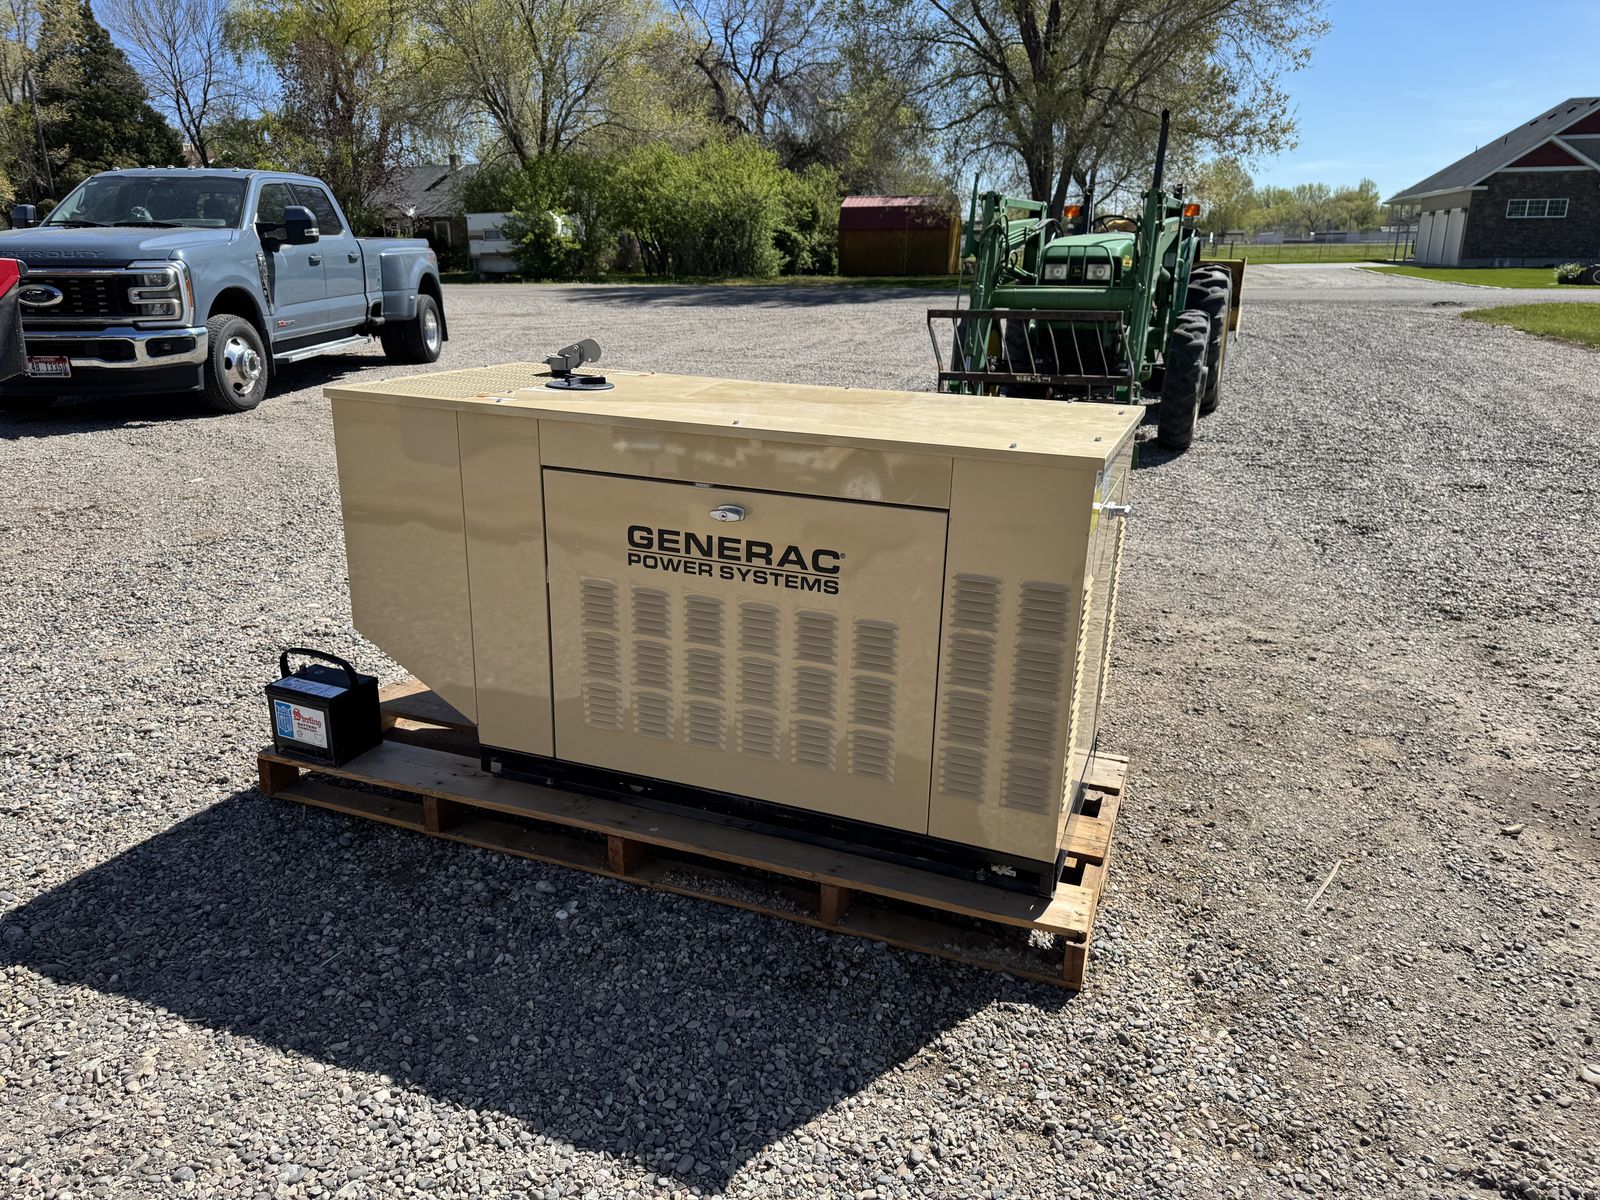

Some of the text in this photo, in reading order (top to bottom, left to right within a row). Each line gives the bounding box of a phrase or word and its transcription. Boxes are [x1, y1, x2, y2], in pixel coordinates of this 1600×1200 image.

[47, 250, 105, 258] DUTY
[627, 524, 841, 575] GENERAC
[627, 552, 840, 595] POWER SYSTEMS
